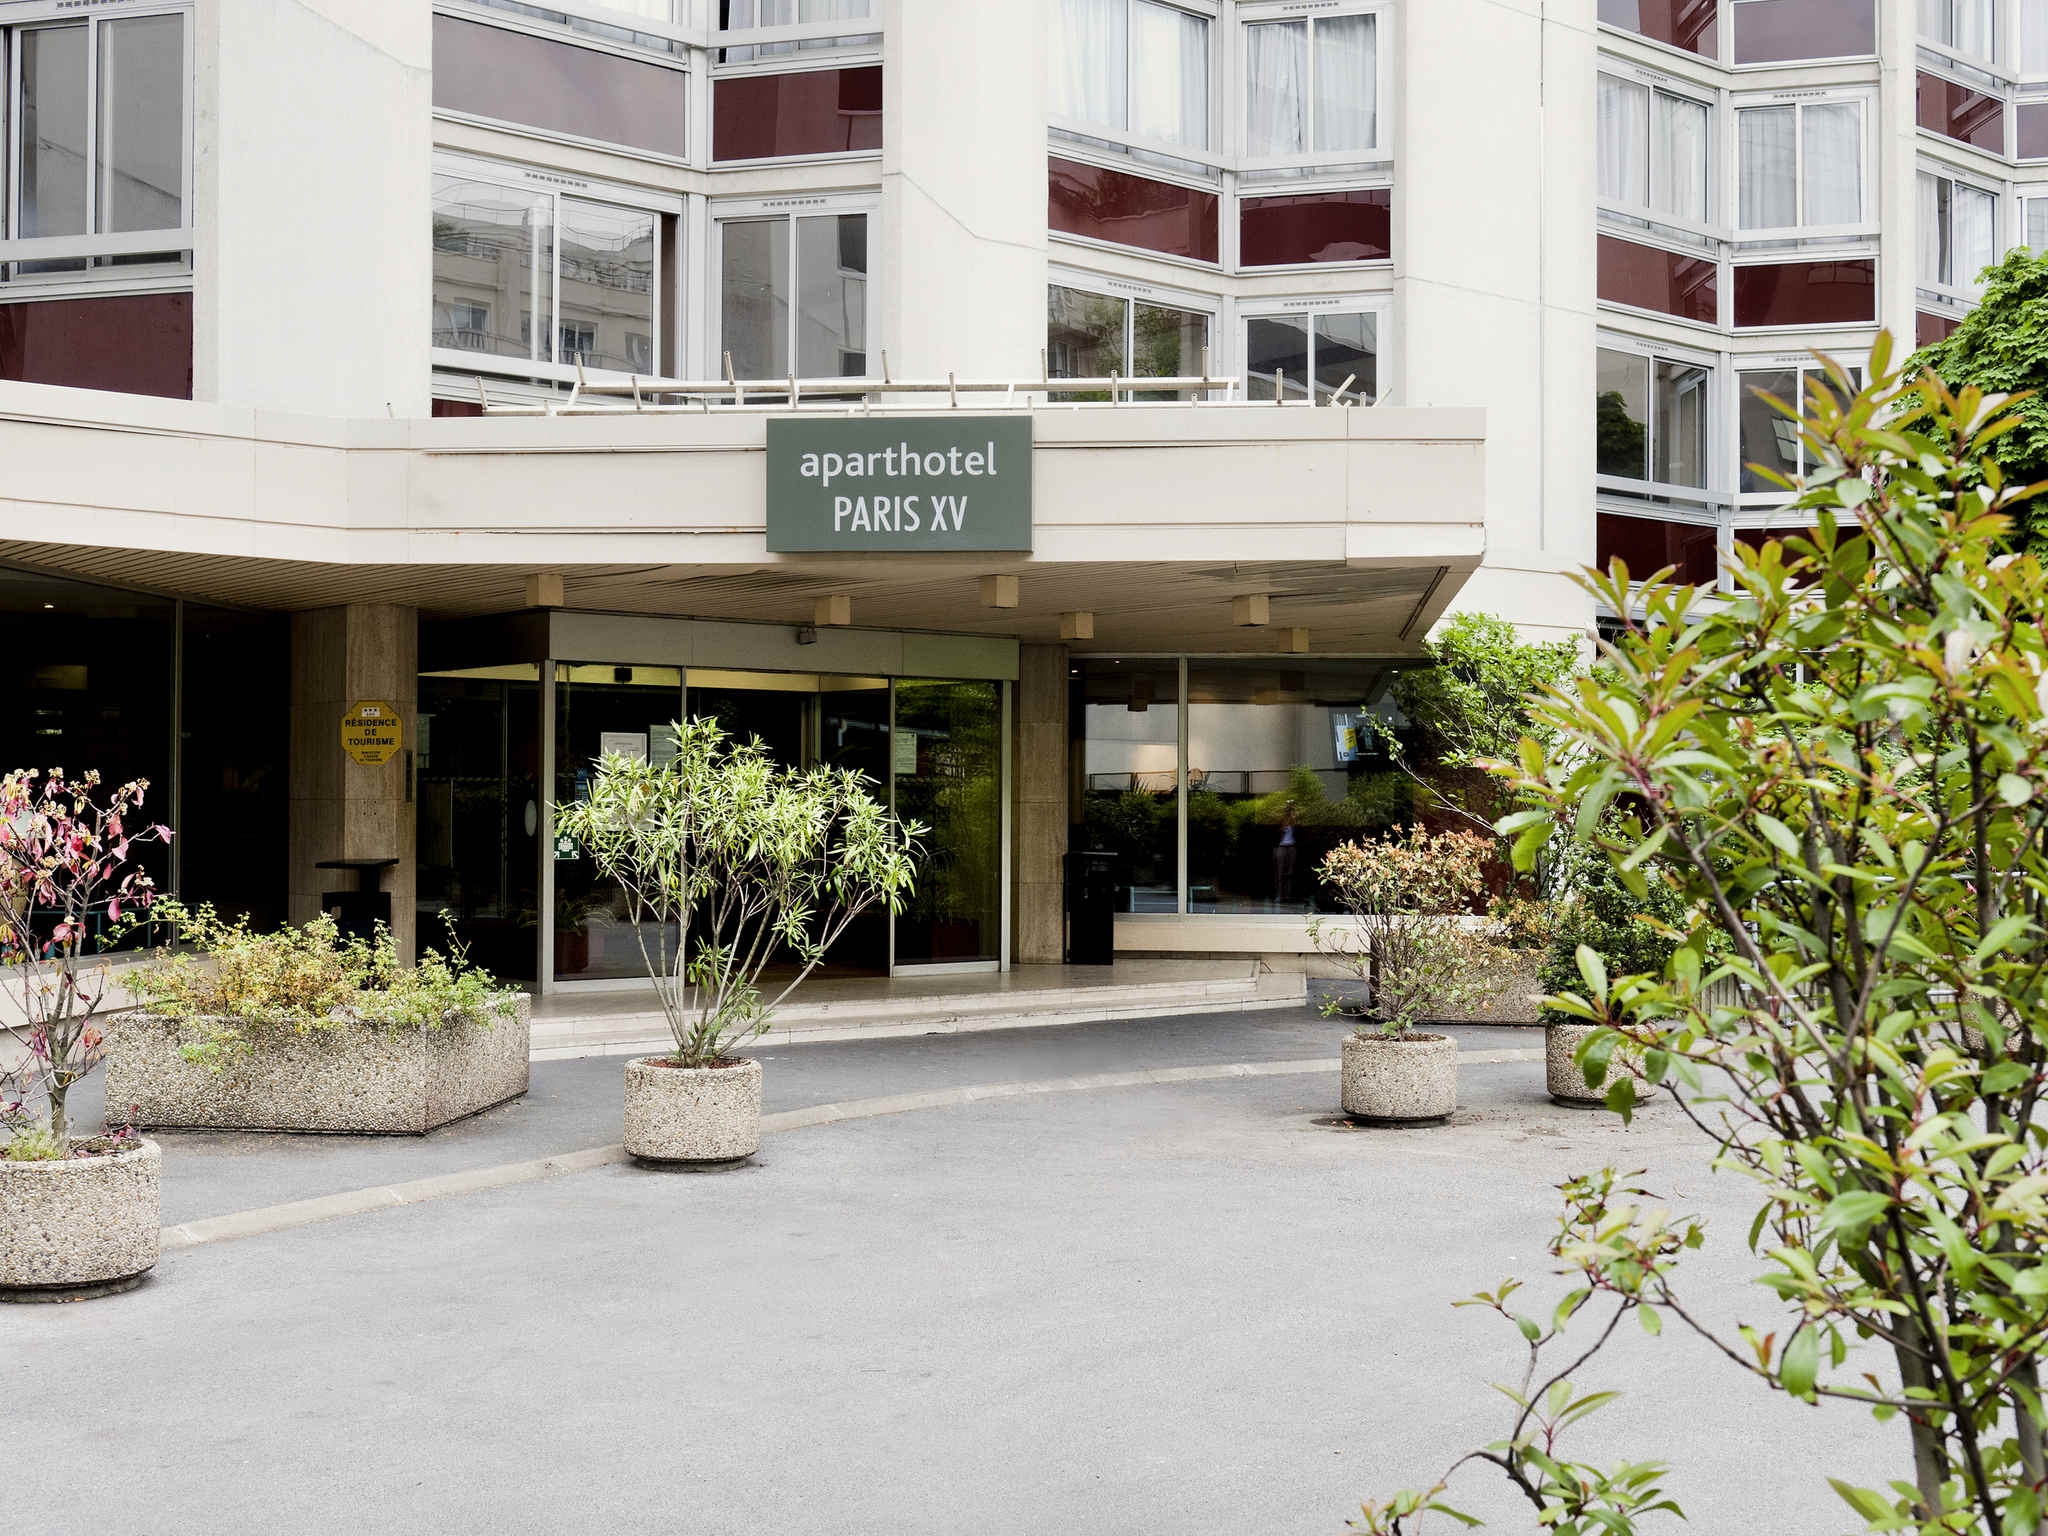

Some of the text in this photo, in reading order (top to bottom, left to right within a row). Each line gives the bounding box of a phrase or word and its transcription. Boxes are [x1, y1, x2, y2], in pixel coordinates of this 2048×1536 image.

[800, 441, 997, 487] aparthotel
[834, 495, 968, 532] PARIS XV
[348, 737, 396, 746] TOURISME
[364, 728, 377, 736] DE
